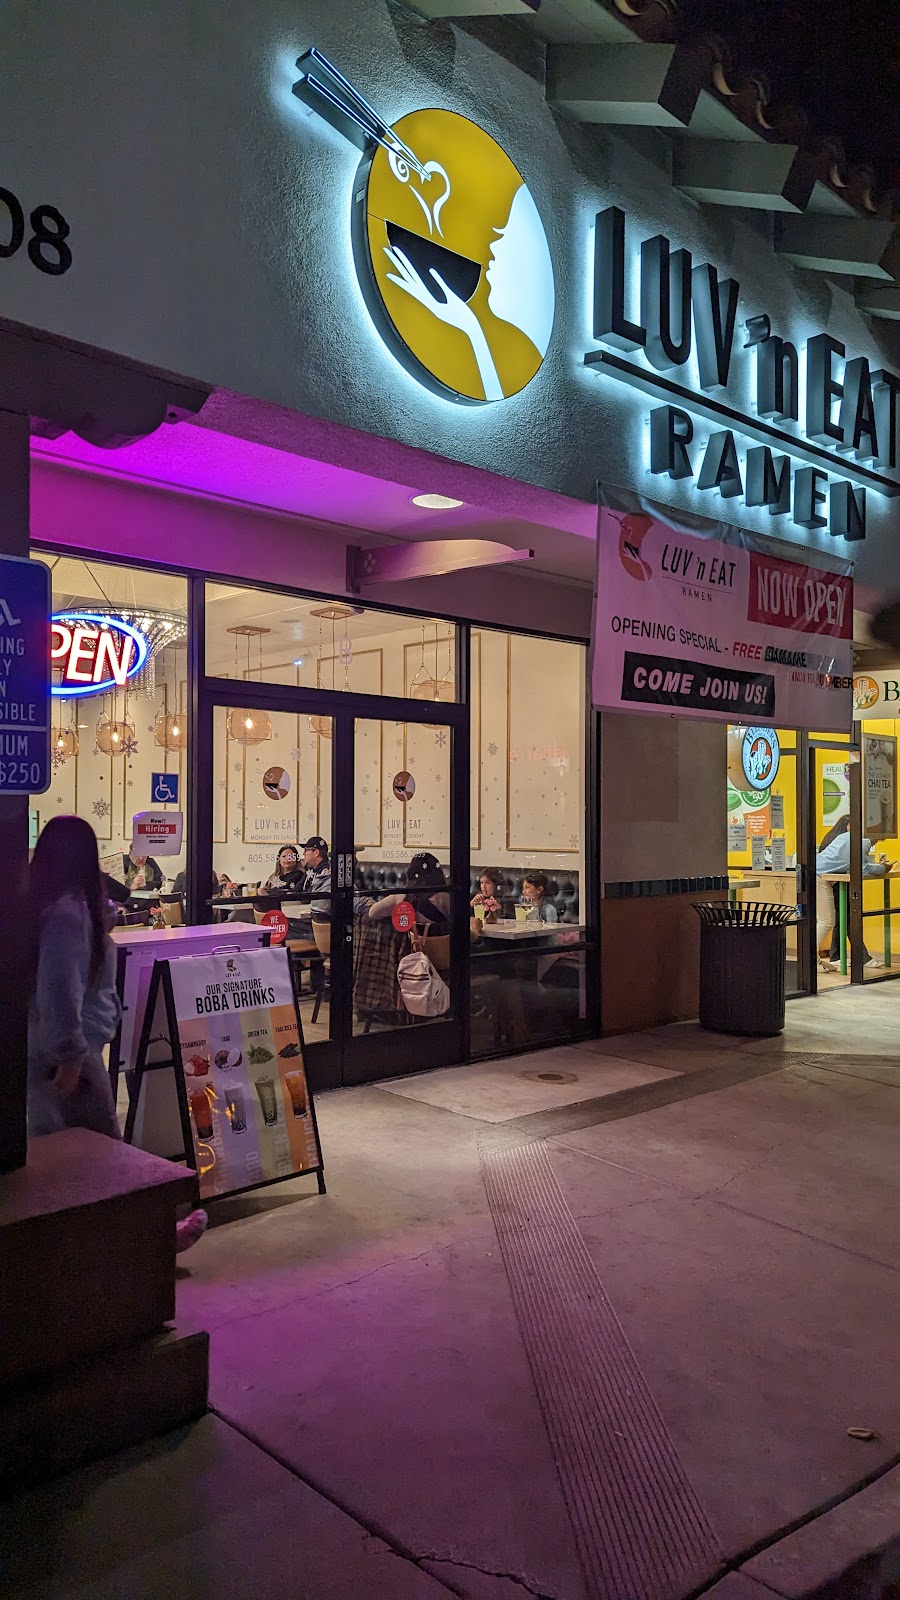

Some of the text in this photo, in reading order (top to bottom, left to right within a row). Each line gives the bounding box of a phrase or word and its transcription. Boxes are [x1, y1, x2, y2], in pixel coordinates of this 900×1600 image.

[593, 205, 740, 392] LUV
[806, 333, 900, 470] EAT
[649, 404, 867, 542] RAMEN
[661, 543, 694, 577] LUV
[708, 557, 737, 588] EAT
[682, 586, 713, 602] RAMEN
[756, 565, 846, 628] NOW OPEN
[611, 615, 676, 642] OPENING
[679, 628, 722, 653] SPECIAL
[732, 641, 763, 660] FREE
[0, 659, 12, 676] Y
[50, 624, 133, 685] PEN
[633, 666, 768, 706] COME JOIN US!
[145, 825, 170, 834] Hiring
[254, 819, 270, 830] LUV
[281, 819, 296, 830] EAT
[387, 819, 401, 829] LUV
[409, 819, 422, 829] EAT
[270, 915, 280, 924] WE
[195, 987, 276, 1015] BOBA DRINKS
[206, 978, 263, 996] OUR SIGNATURE
